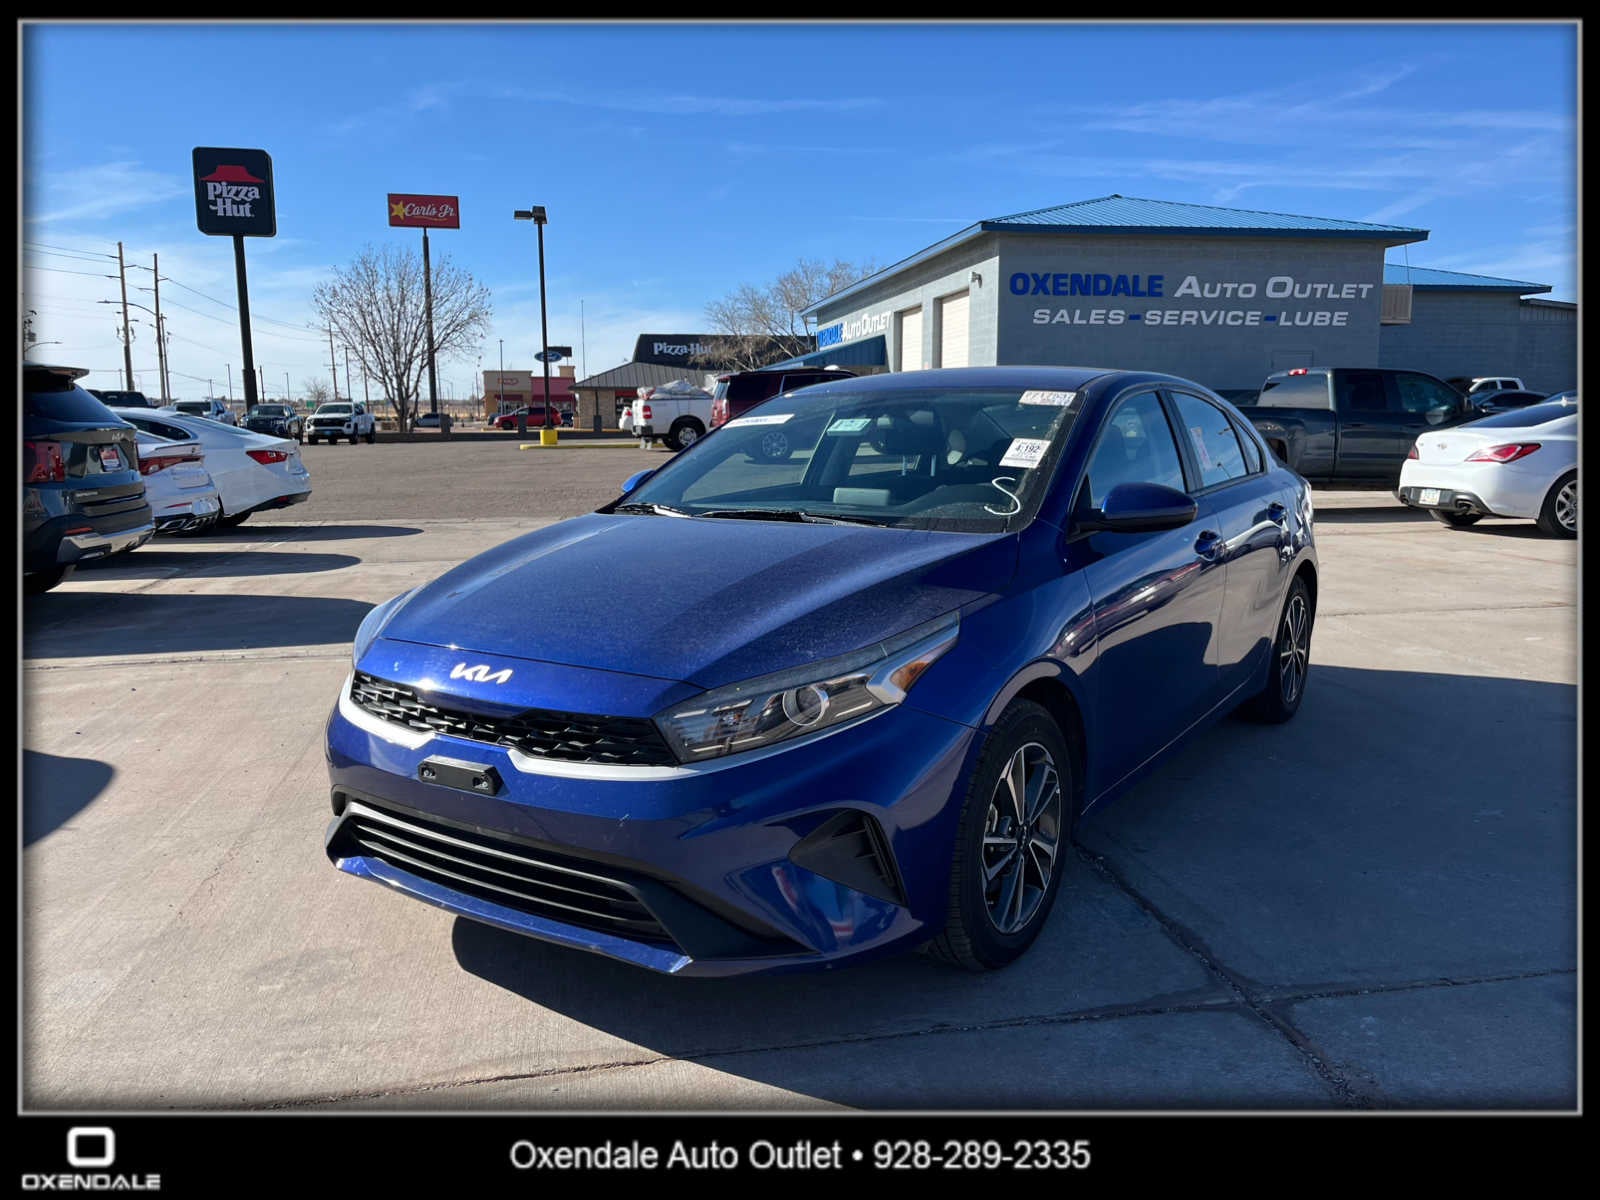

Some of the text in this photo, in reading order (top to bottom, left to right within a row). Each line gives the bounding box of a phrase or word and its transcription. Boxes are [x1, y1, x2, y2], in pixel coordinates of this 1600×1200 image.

[207, 182, 260, 201] Pizza
[209, 198, 251, 217] Hut
[1009, 272, 1164, 297] OXENDALE
[653, 342, 688, 355] Pizza
